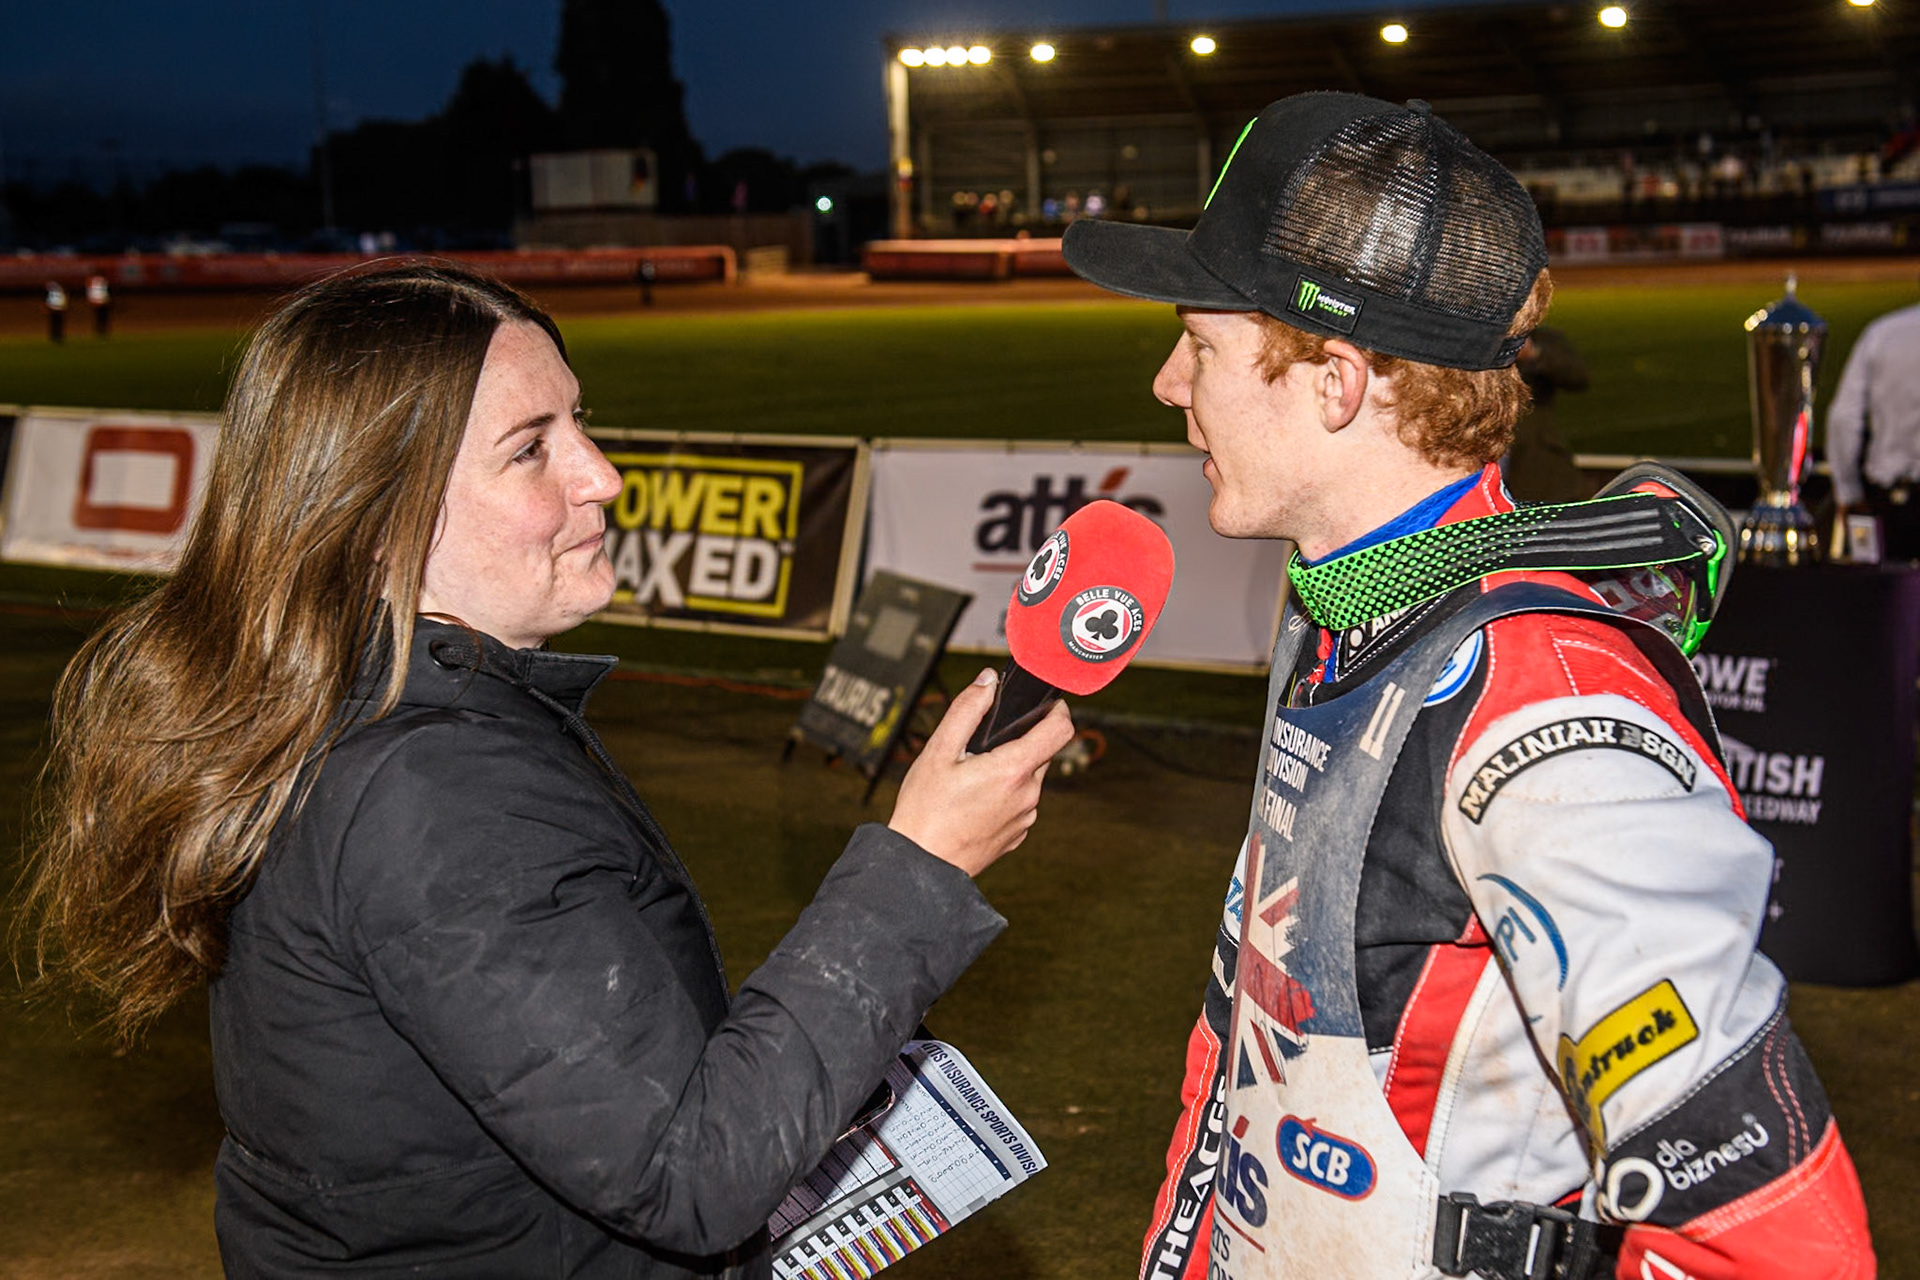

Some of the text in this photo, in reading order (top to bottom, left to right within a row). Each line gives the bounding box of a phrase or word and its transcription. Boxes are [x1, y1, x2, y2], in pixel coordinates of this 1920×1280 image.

[606, 469, 787, 540] OWER
[975, 467, 1167, 551] att
[1053, 553, 1066, 580] ACES
[1076, 589, 1143, 632] BELLE VUE ACES
[1694, 653, 1769, 695] OWE
[1707, 692, 1740, 709] OTOR
[1271, 716, 1332, 773] INSURANCE
[1734, 752, 1824, 797] TISH
[1744, 795, 1822, 824] EEDWAY
[939, 1059, 989, 1114] INSURANCE
[980, 1108, 1019, 1146] SPORTS
[1292, 1132, 1351, 1186] SCB
[1656, 1138, 1698, 1169] dla
[1664, 1121, 1769, 1191] biznesu
